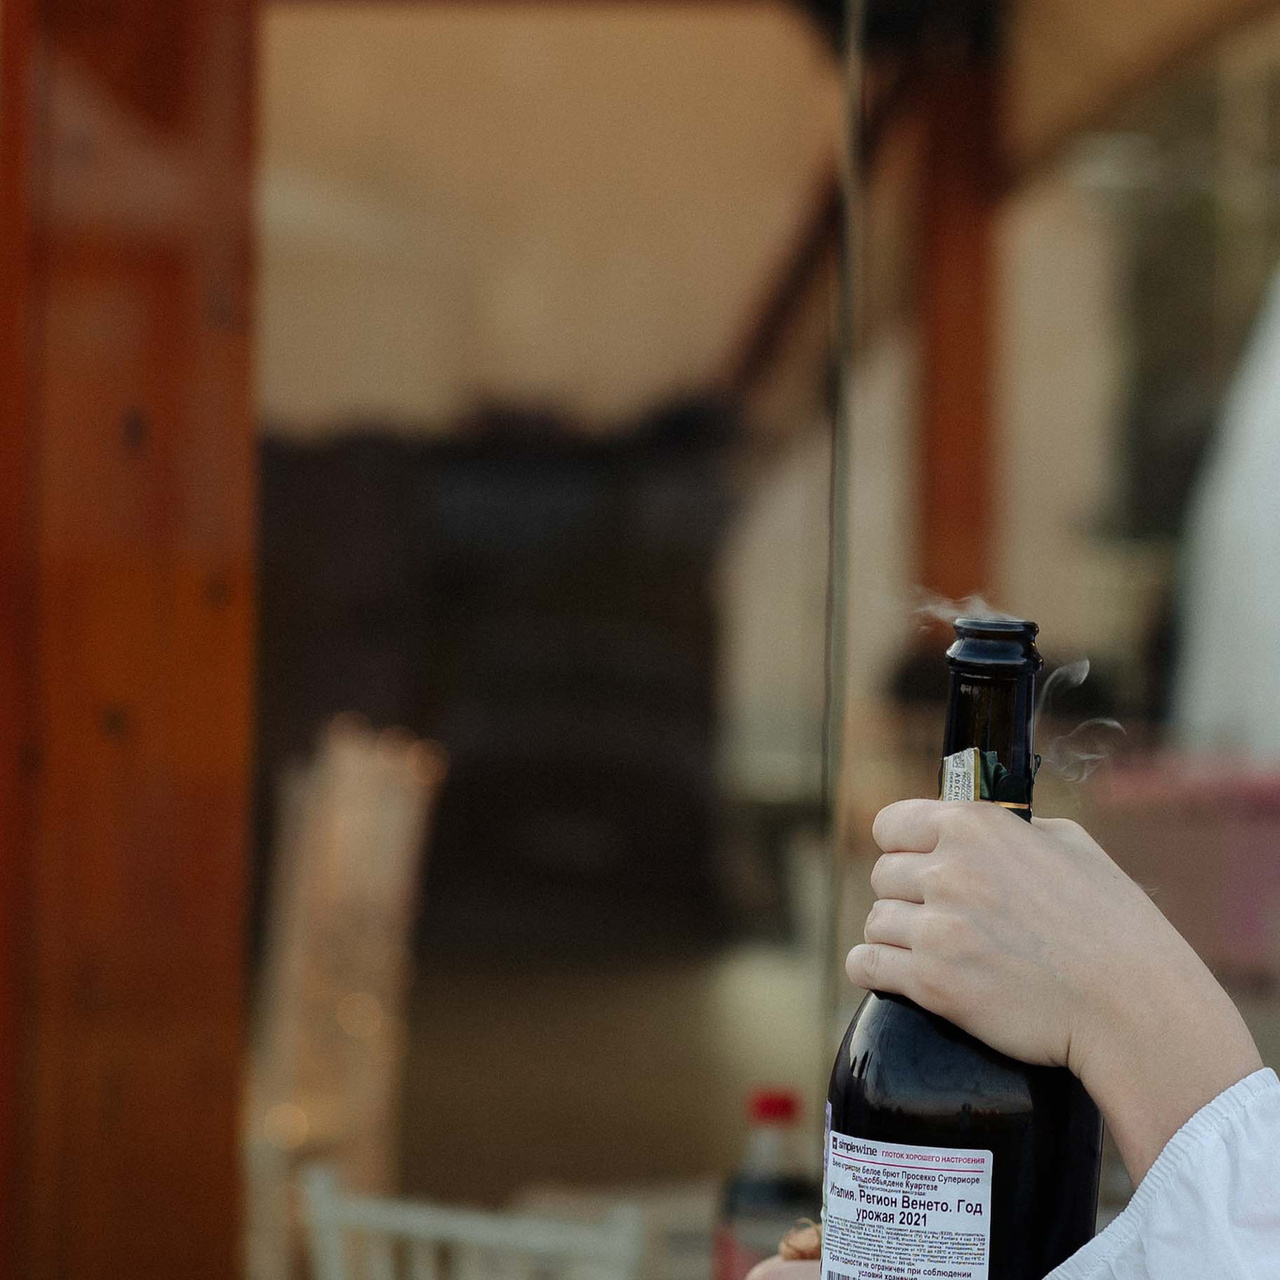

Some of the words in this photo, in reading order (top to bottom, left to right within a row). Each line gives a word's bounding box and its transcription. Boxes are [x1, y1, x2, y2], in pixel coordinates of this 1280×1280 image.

[881, 1150, 904, 1158] ГЛОТОК
[905, 1153, 940, 1162] ХОРОШЕГО
[941, 1156, 985, 1164] НАСТРОЕНИЯ
[882, 1168, 900, 1179] брют
[901, 1170, 937, 1182] Просекко
[937, 1173, 981, 1186] Супериоре
[905, 1180, 939, 1191] Куартезе
[859, 1189, 898, 1208] Регион
[901, 1195, 953, 1213] Венето.
[957, 1199, 984, 1216] Год
[856, 1208, 895, 1224] урожая
[898, 1211, 927, 1227] 2021
[870, 1263, 905, 1274] ограничен
[906, 1267, 921, 1276] при
[922, 1268, 972, 1278] соблюдении
